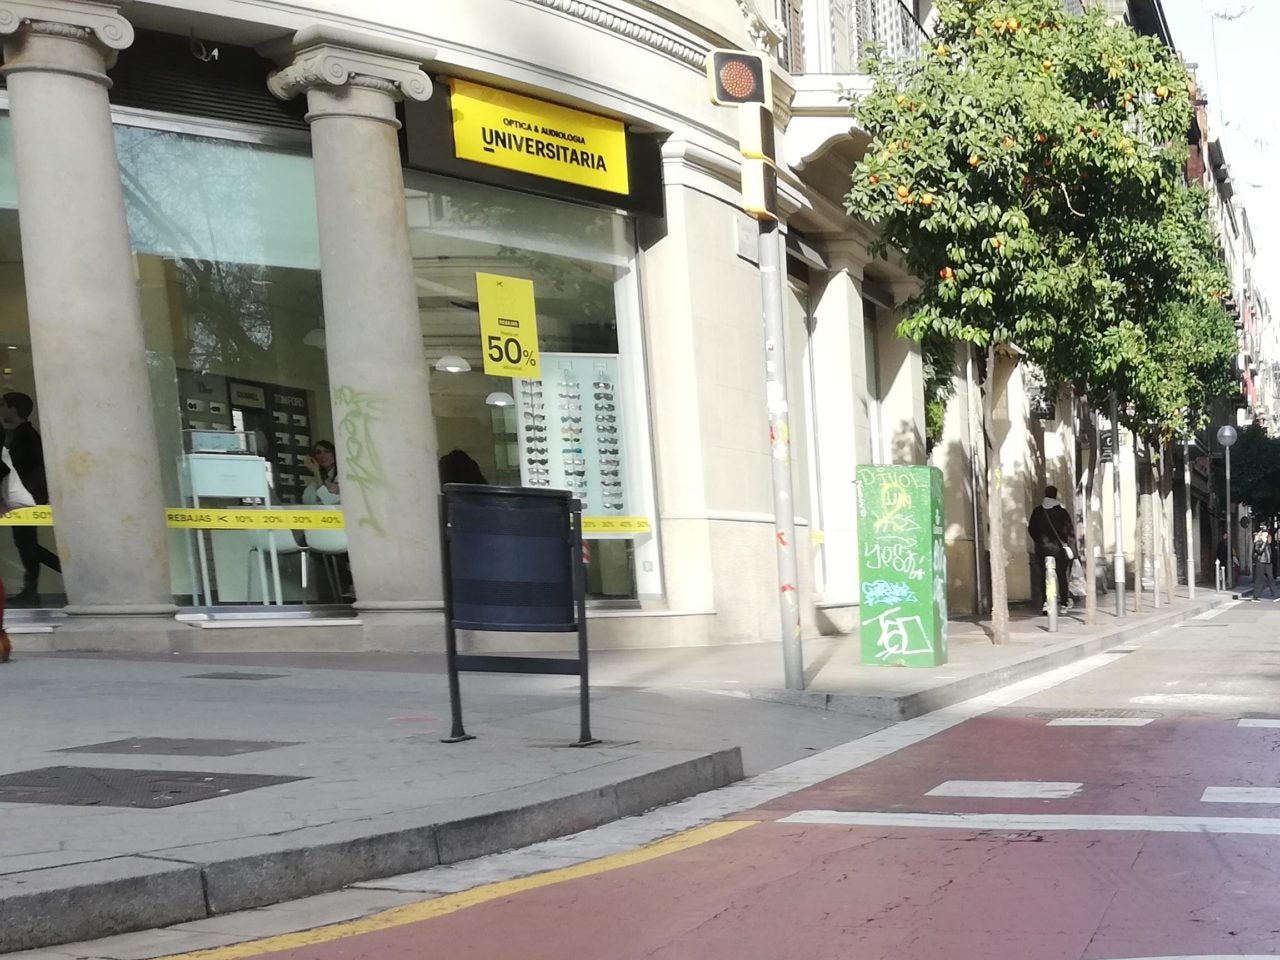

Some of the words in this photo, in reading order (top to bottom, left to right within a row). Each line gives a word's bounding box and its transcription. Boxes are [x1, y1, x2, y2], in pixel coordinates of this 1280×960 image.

[503, 117, 532, 132] OPTICA
[534, 125, 539, 133] &
[541, 127, 586, 144] AUDIOLOGIA
[481, 126, 607, 172] UNIVERSITARIA
[487, 335, 536, 367] 50%
[0, 511, 22, 519] 0%
[167, 513, 212, 523] REBAJAS
[235, 515, 254, 523] 10%
[263, 515, 284, 524] 20%
[292, 516, 312, 524] 30%
[321, 516, 341, 524] 40%
